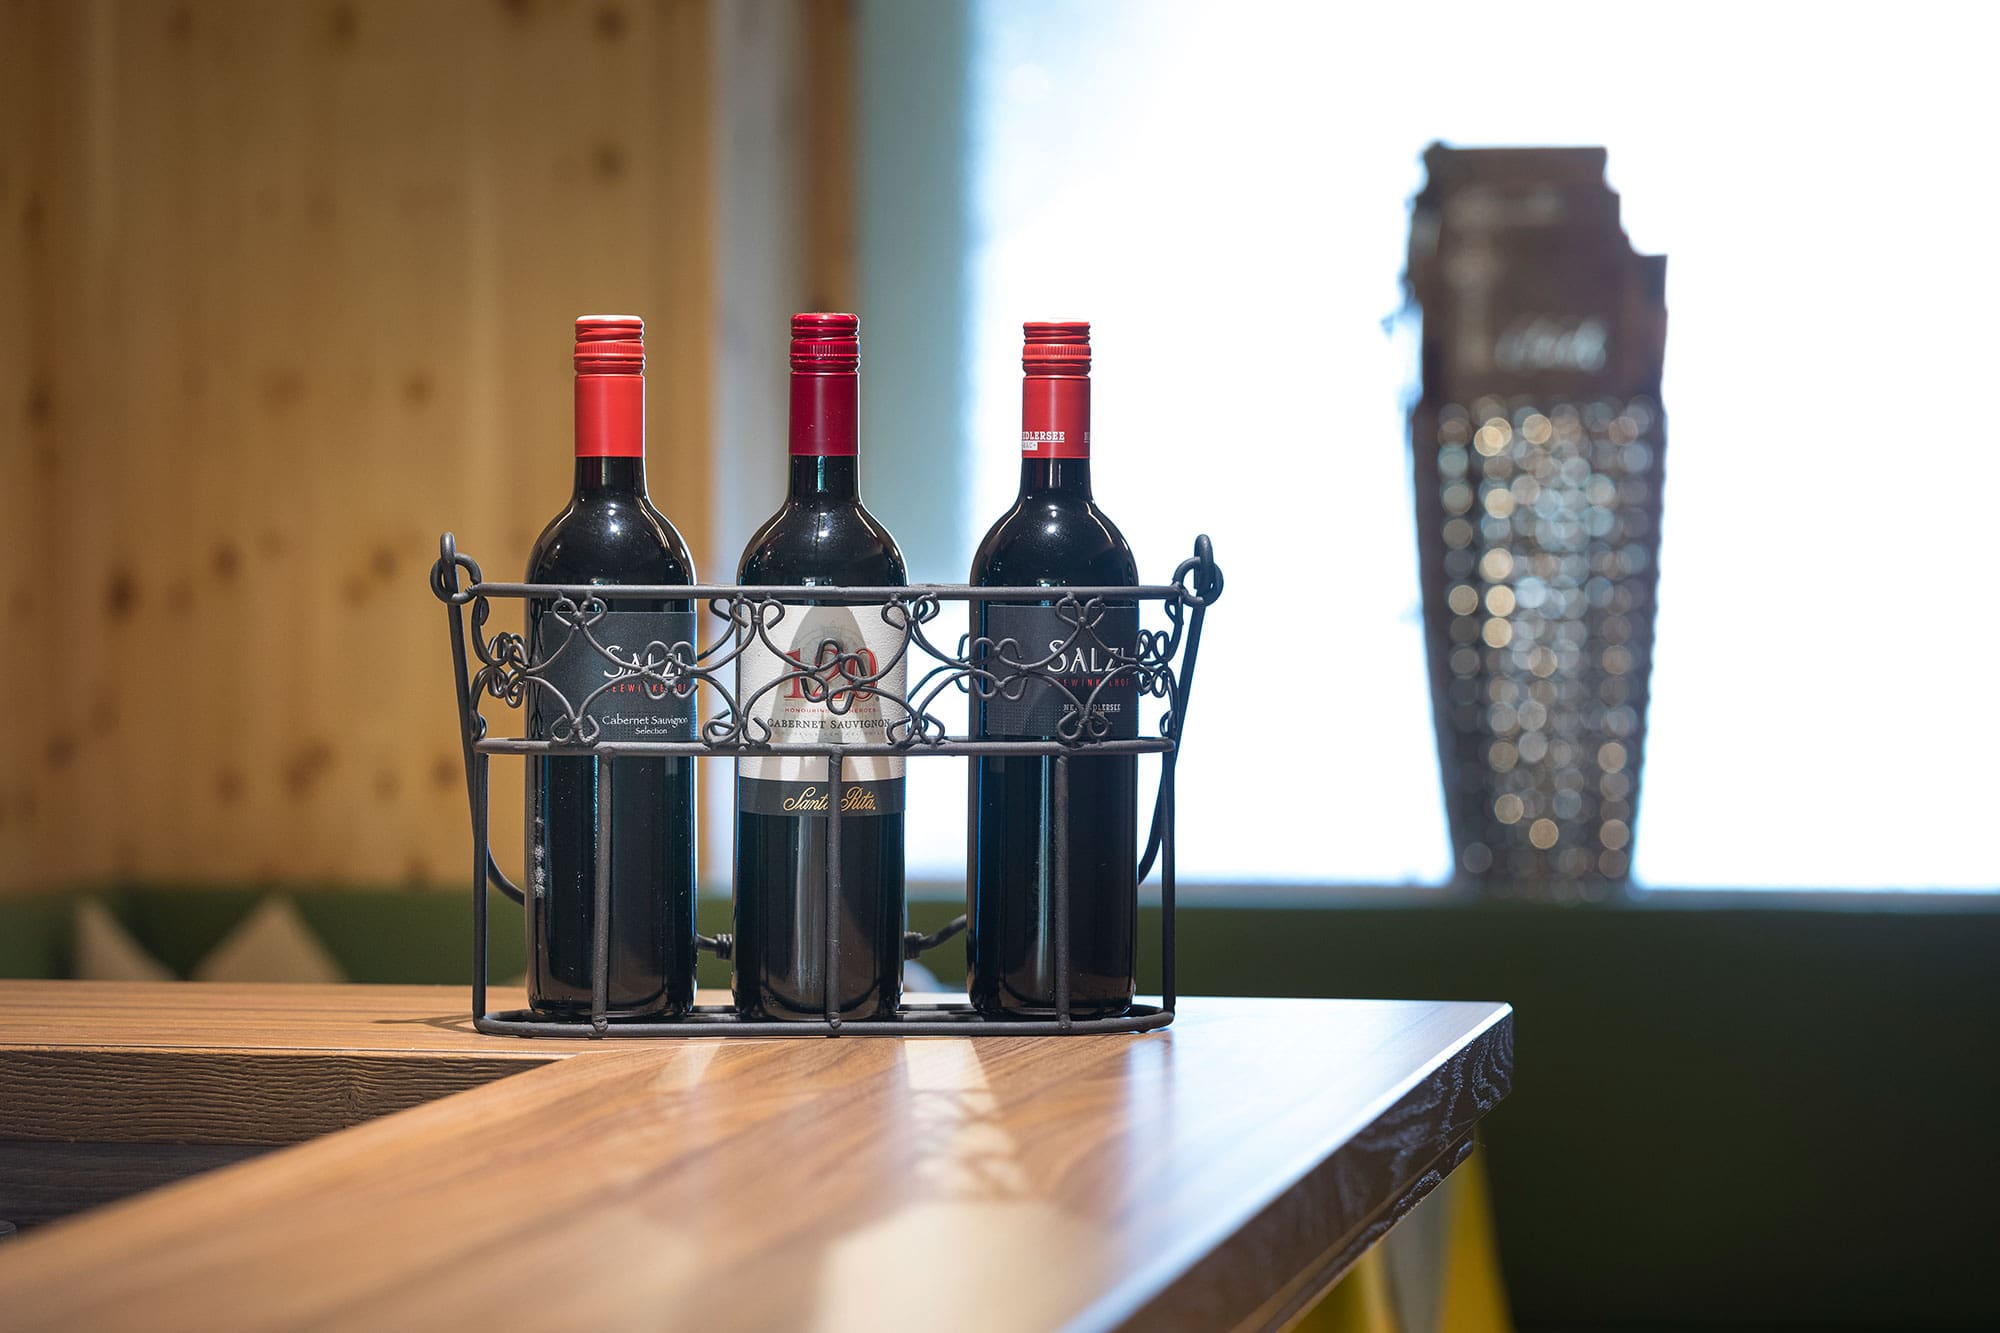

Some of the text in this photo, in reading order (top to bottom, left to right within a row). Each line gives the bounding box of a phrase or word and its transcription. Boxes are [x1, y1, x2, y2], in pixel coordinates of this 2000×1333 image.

[602, 713, 688, 728] Cabernet Sauvignon
[767, 719, 890, 729] CABERNET SAUVIGNON
[635, 725, 668, 735] Selection
[783, 786, 829, 811] Sant
